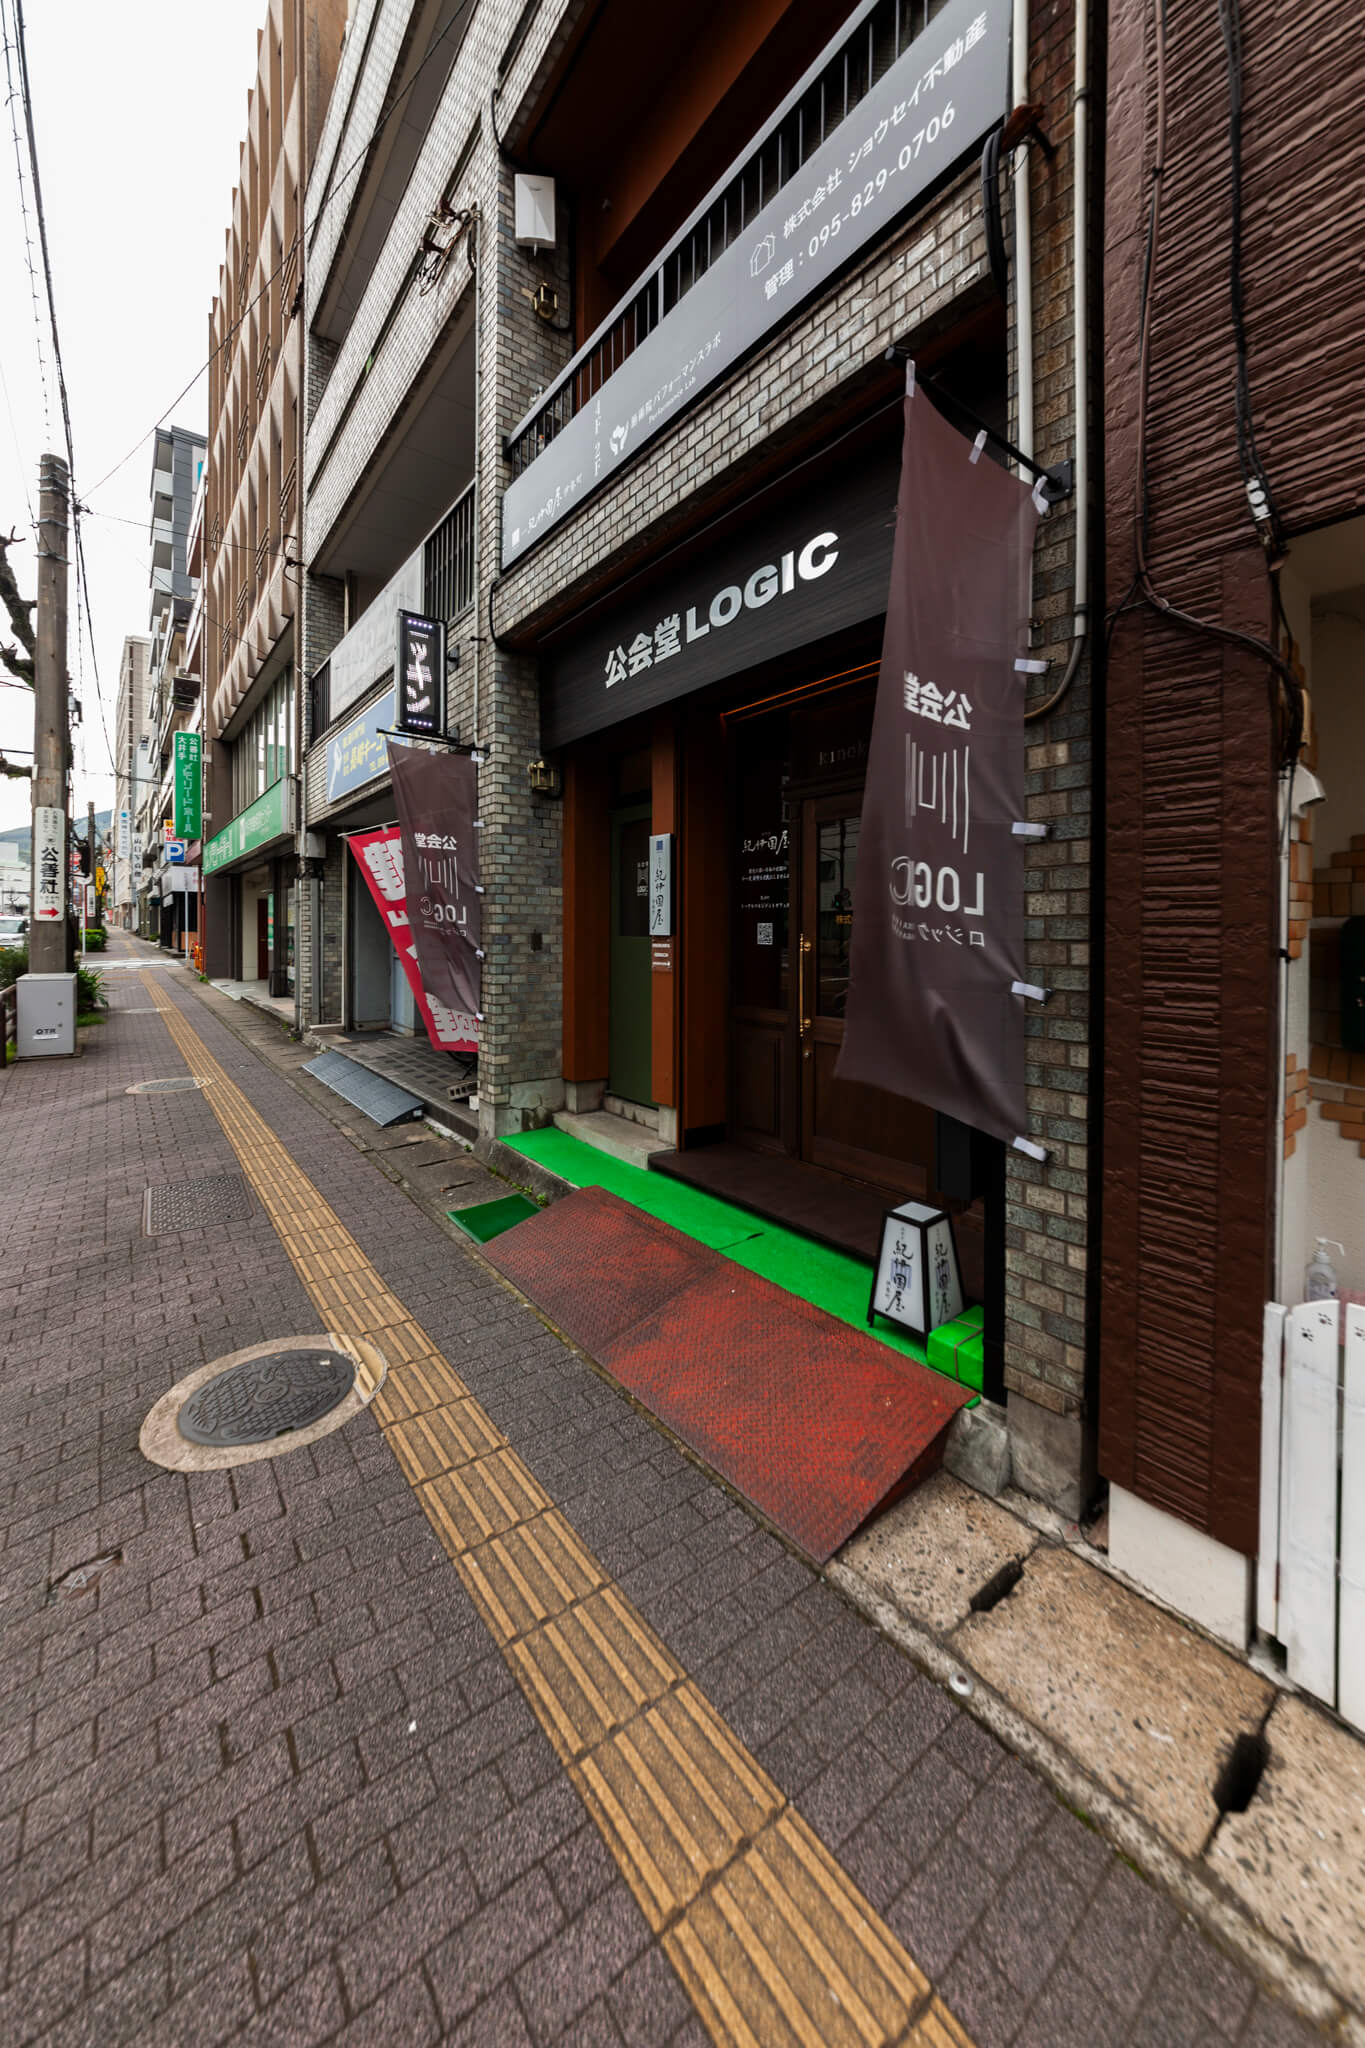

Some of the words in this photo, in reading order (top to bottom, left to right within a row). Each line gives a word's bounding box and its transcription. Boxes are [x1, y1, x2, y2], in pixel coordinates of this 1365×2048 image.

[783, 167, 842, 240] 株式会社
[848, 11, 988, 173] ショウセイ不動産
[808, 100, 956, 257] 095-829-0706
[604, 613, 682, 689] 公会堂
[686, 532, 839, 644] LOGIC
[40, 846, 60, 895] 公善社
[166, 844, 184, 861] P
